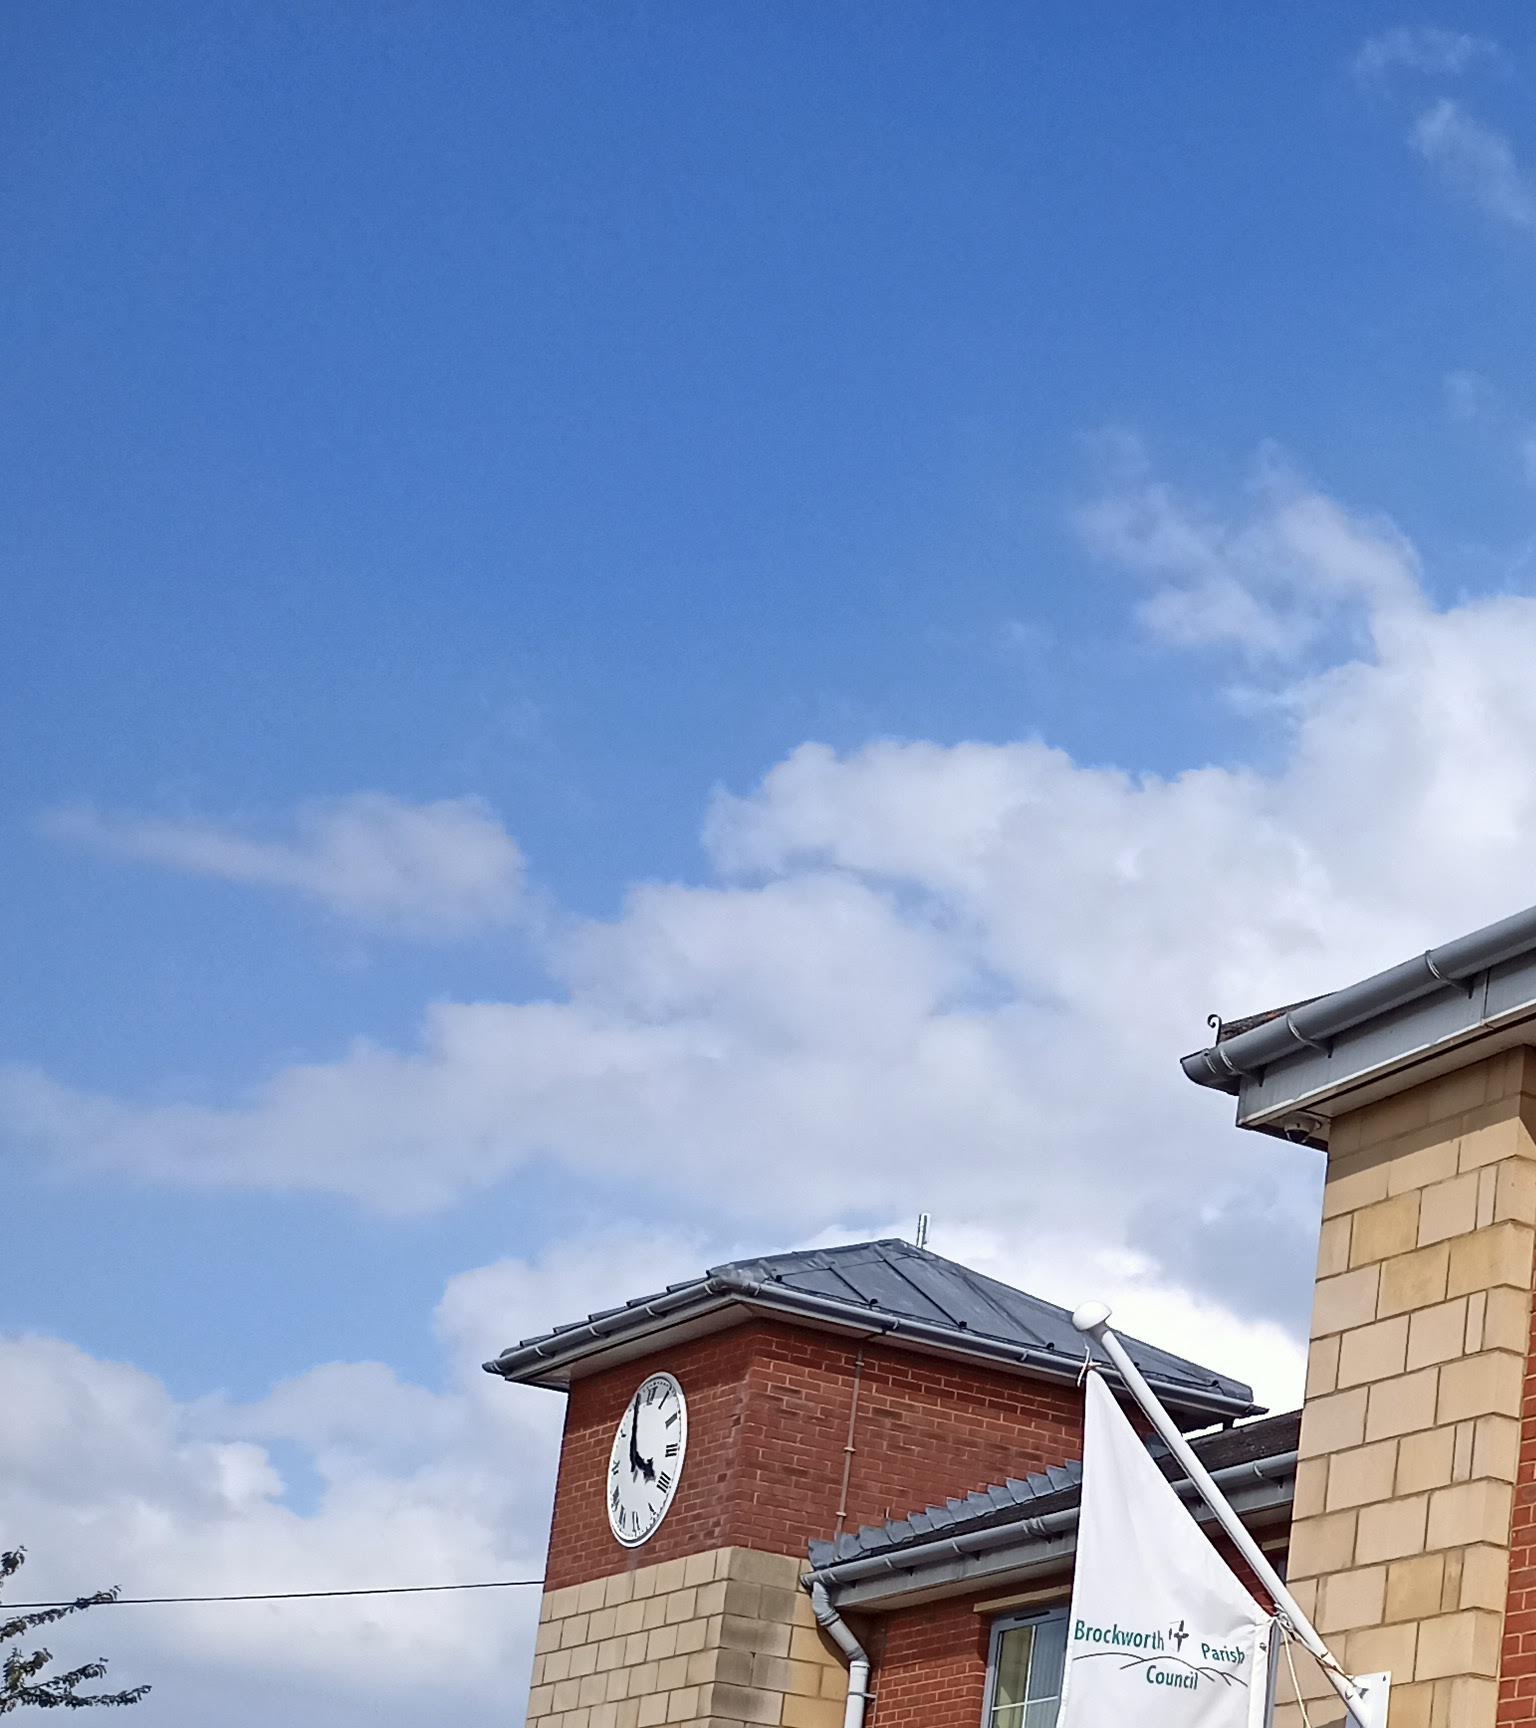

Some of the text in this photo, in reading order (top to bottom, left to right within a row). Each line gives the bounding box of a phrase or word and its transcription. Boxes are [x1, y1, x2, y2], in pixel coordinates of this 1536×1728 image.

[1074, 1619, 1246, 1664] Brockworth Parish
[1146, 1665, 1198, 1690] Council
